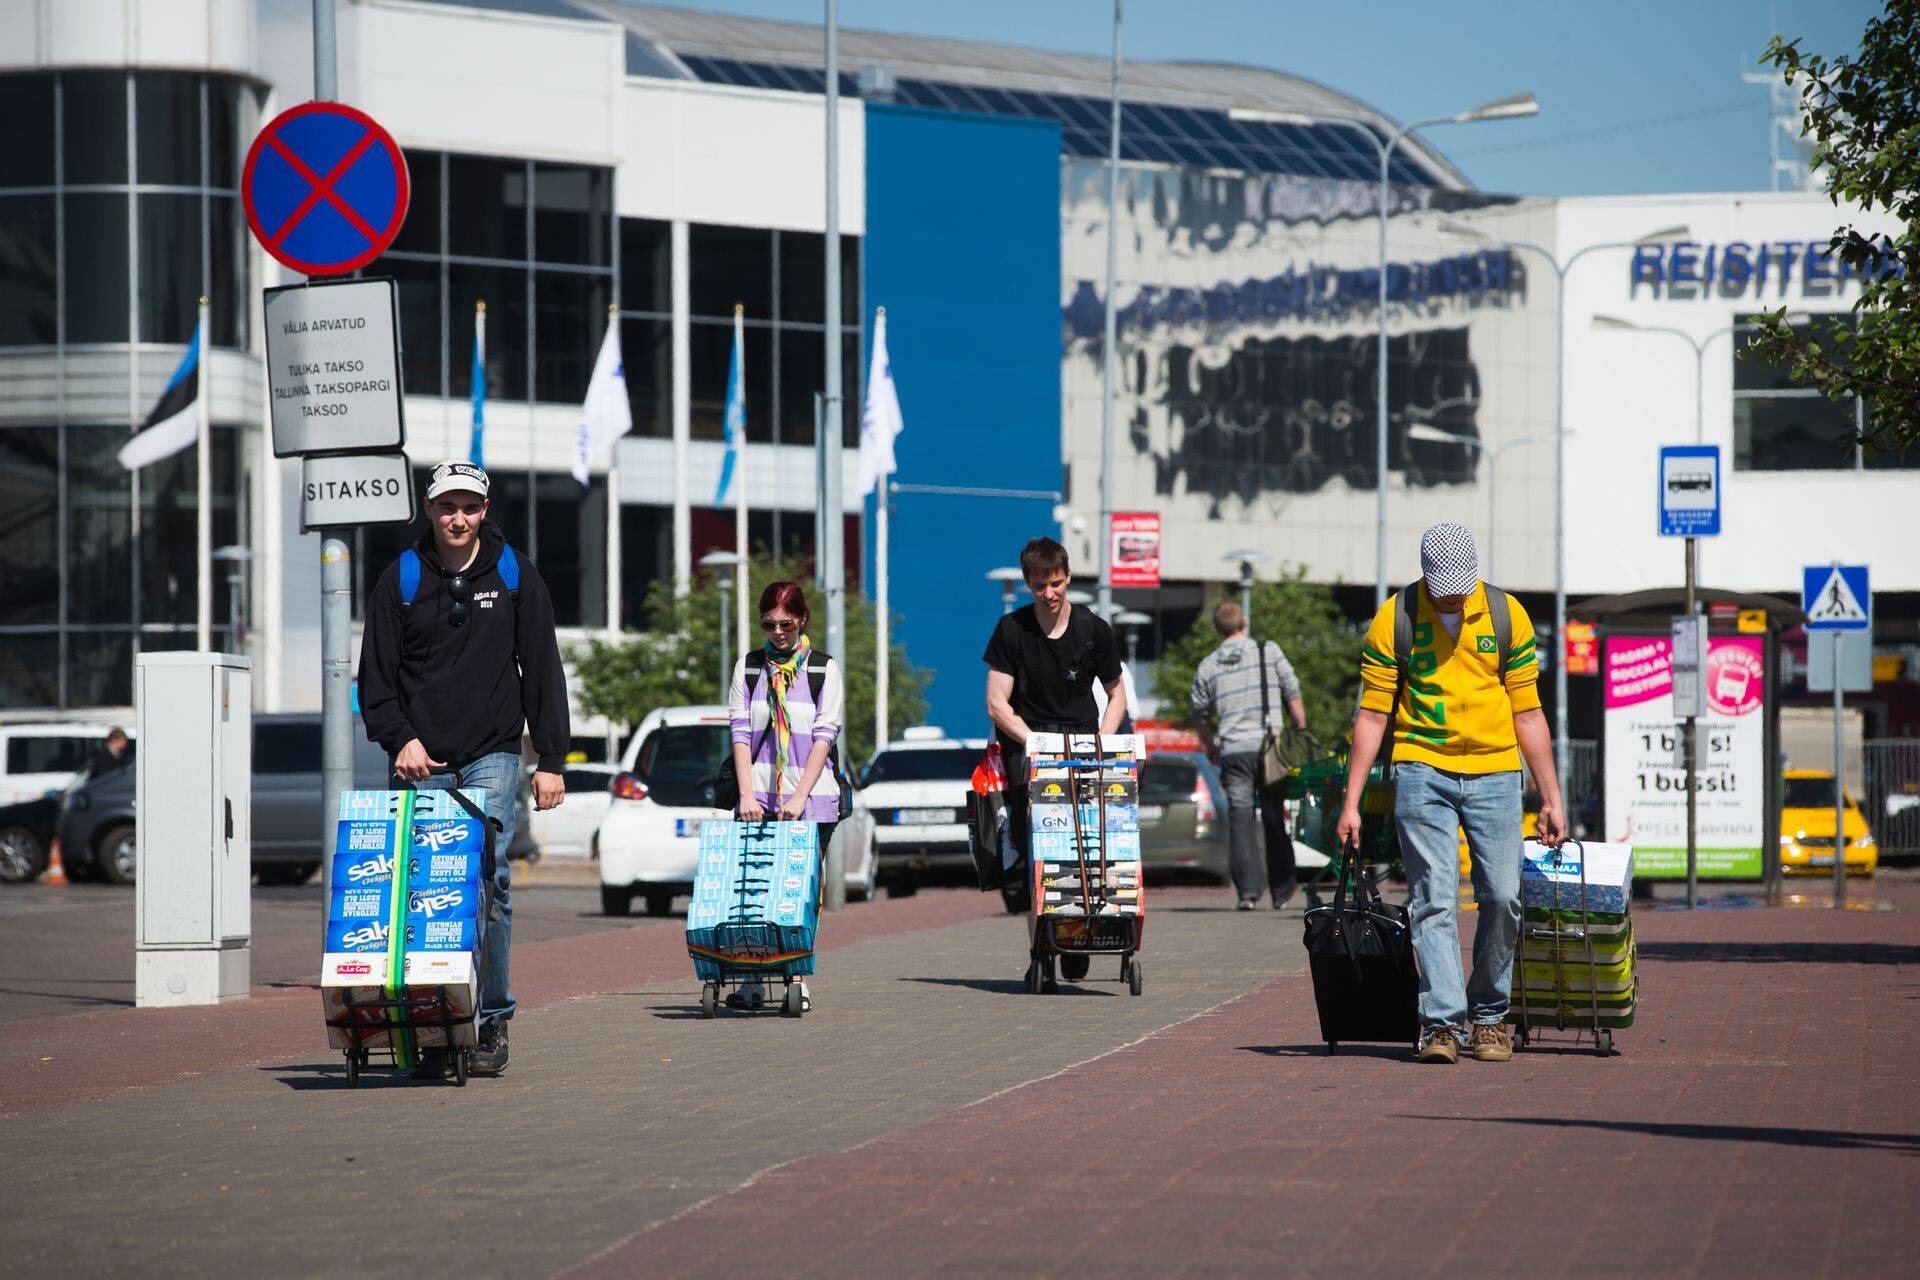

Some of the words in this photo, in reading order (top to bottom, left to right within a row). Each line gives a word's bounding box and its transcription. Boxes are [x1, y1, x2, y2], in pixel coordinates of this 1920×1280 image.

[1634, 241, 1905, 283] REISITE
[311, 317, 366, 331] ARVATUD
[288, 363, 320, 376] TULIKA
[323, 360, 364, 373] TAKSO
[274, 384, 310, 399] TALLINNA
[315, 379, 390, 395] TAKSOPARGI
[301, 403, 348, 417] TAKSOD
[307, 478, 399, 501] SITAKSO
[1641, 735, 1651, 751] 1
[1661, 735, 1731, 751] bs!
[1637, 774, 1646, 791] 1
[415, 824, 469, 852] sak
[347, 853, 394, 882] sak
[412, 889, 463, 919] sak
[342, 920, 389, 949] sak
